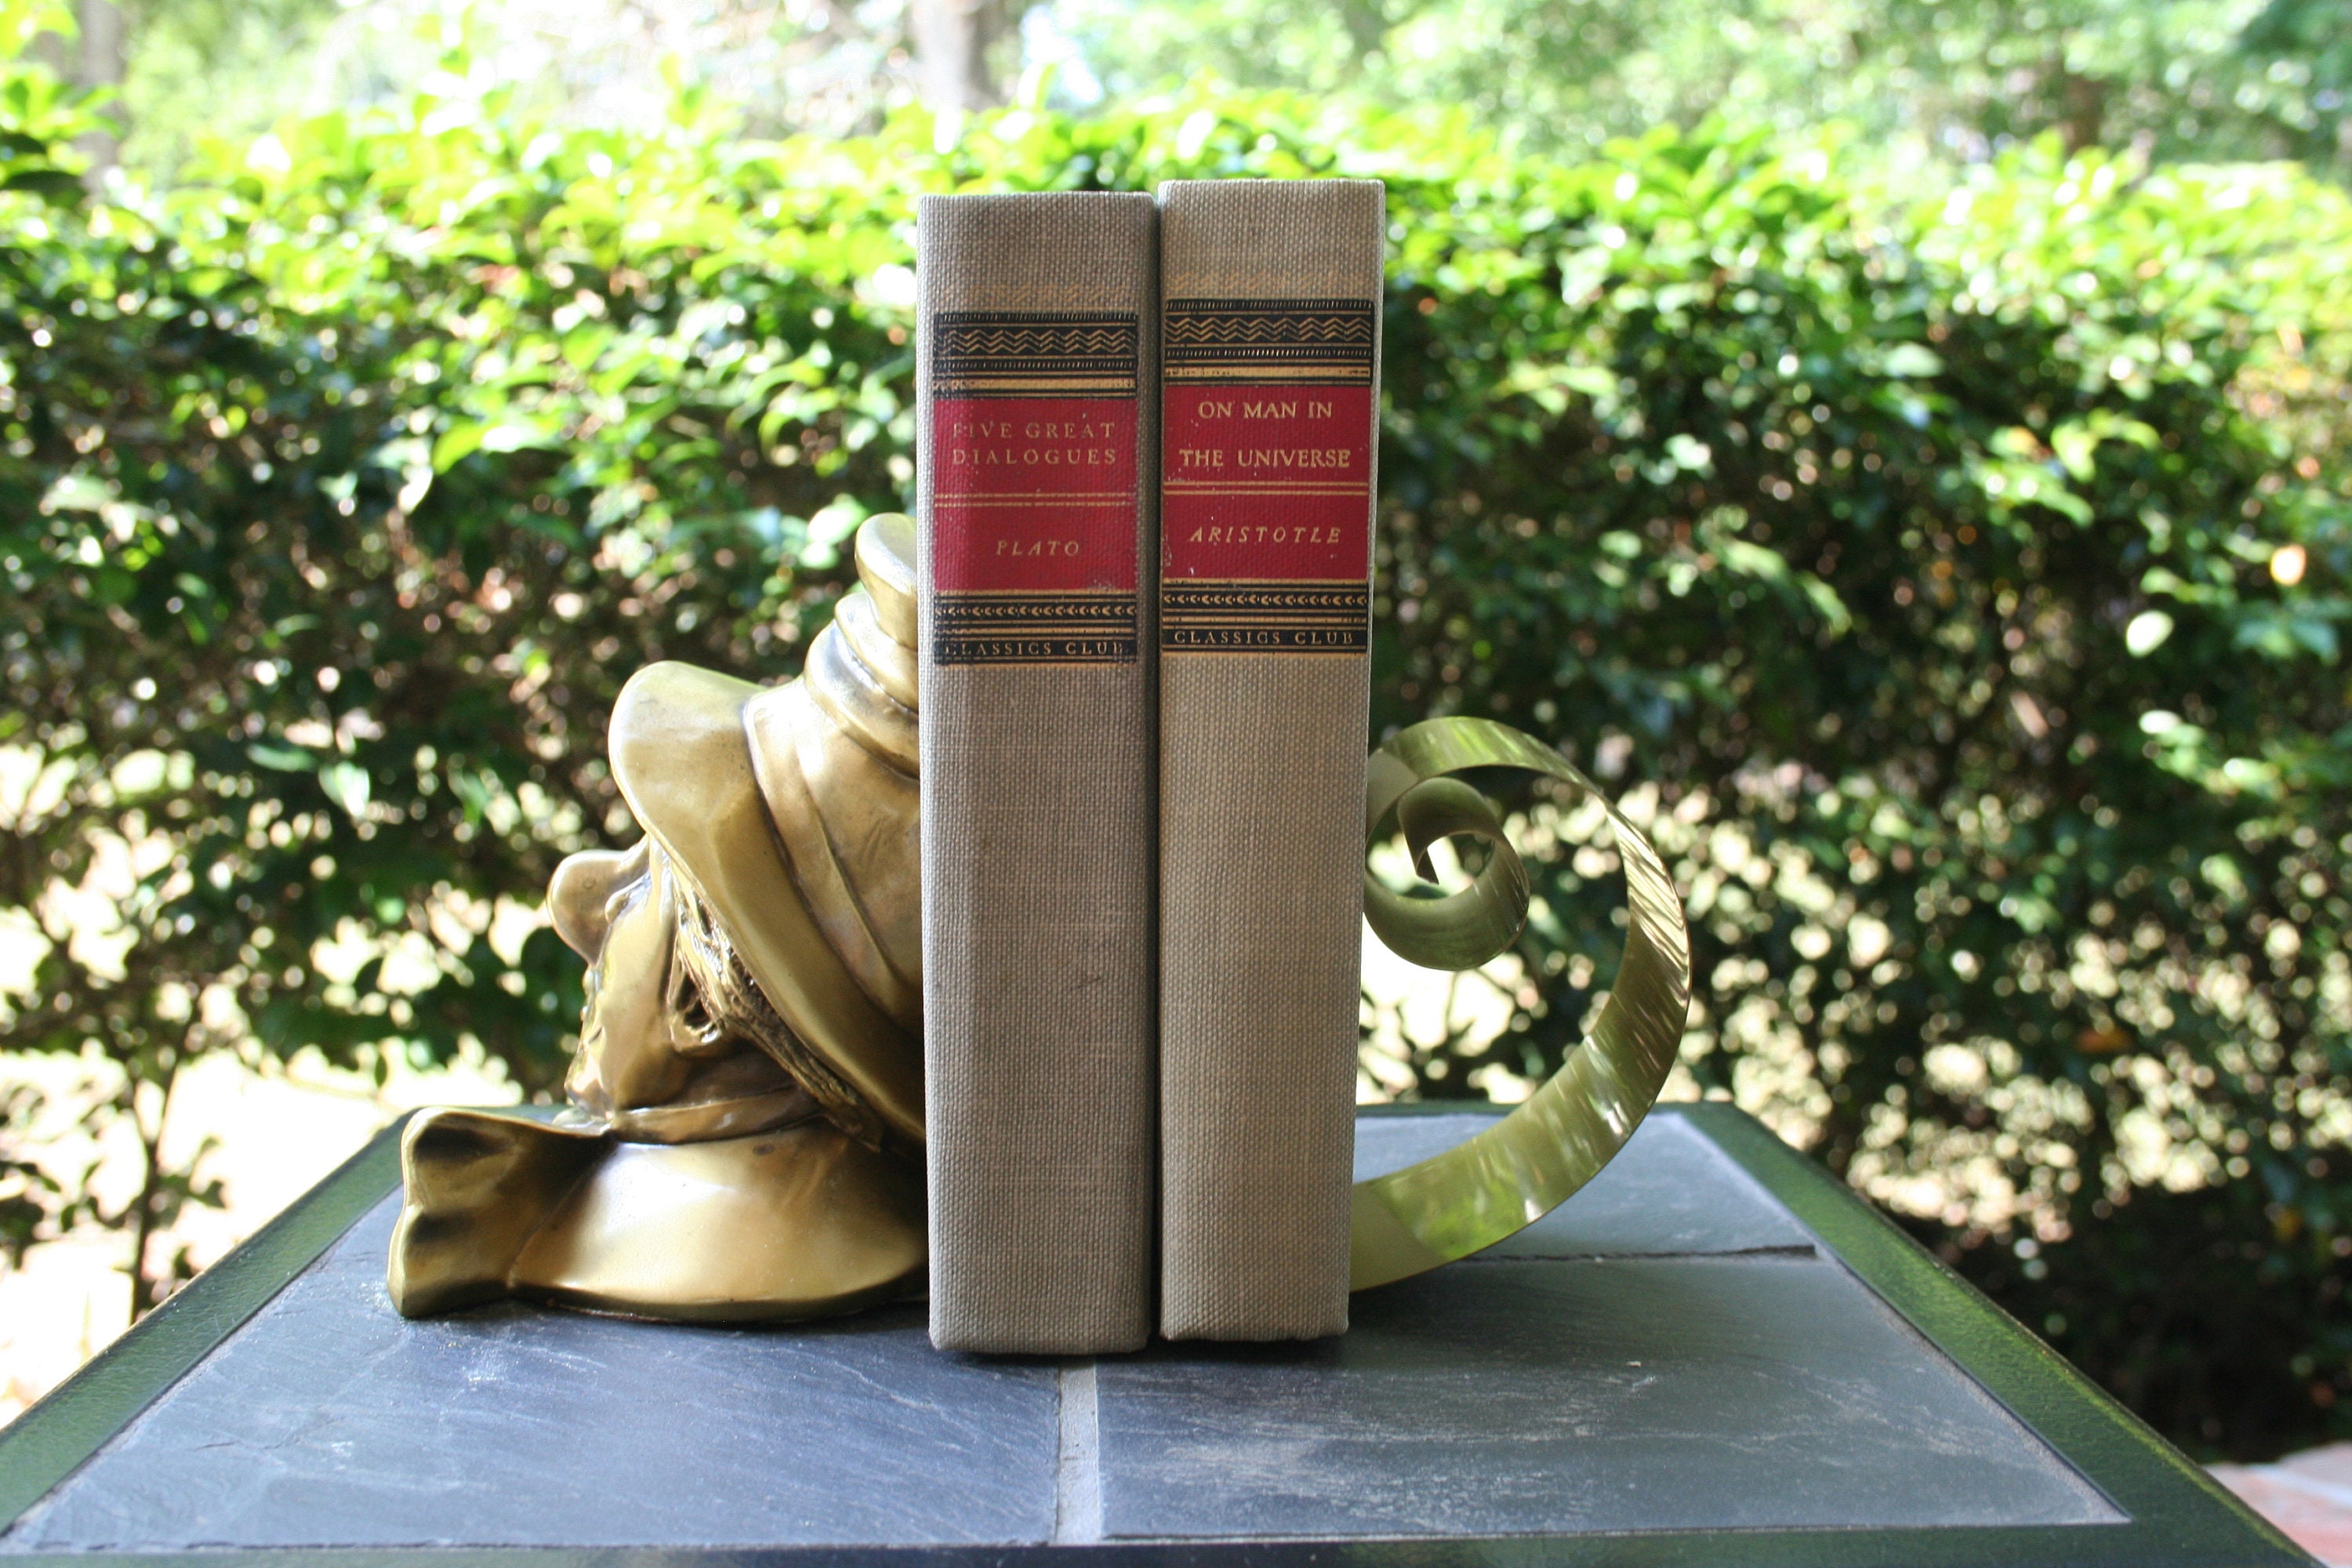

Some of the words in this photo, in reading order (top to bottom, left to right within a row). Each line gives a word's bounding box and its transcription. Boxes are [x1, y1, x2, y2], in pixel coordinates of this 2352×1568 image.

[1197, 401, 1233, 419] ON
[1243, 401, 1298, 419] MAN
[1308, 401, 1333, 419] IN
[952, 423, 1013, 439] FIVE
[1025, 422, 1116, 439] GREAT
[952, 448, 1117, 465] DIALOGUES
[1178, 449, 1224, 467] THE
[1237, 449, 1351, 468] UNIVERSE
[1189, 527, 1341, 543] ARISTOTLE
[996, 540, 1080, 557] PLATO
[1174, 630, 1281, 644] CLASSICS
[1294, 631, 1353, 645] CLUB
[945, 641, 1052, 656] CLASSICS
[1065, 641, 1124, 655] CLUB
